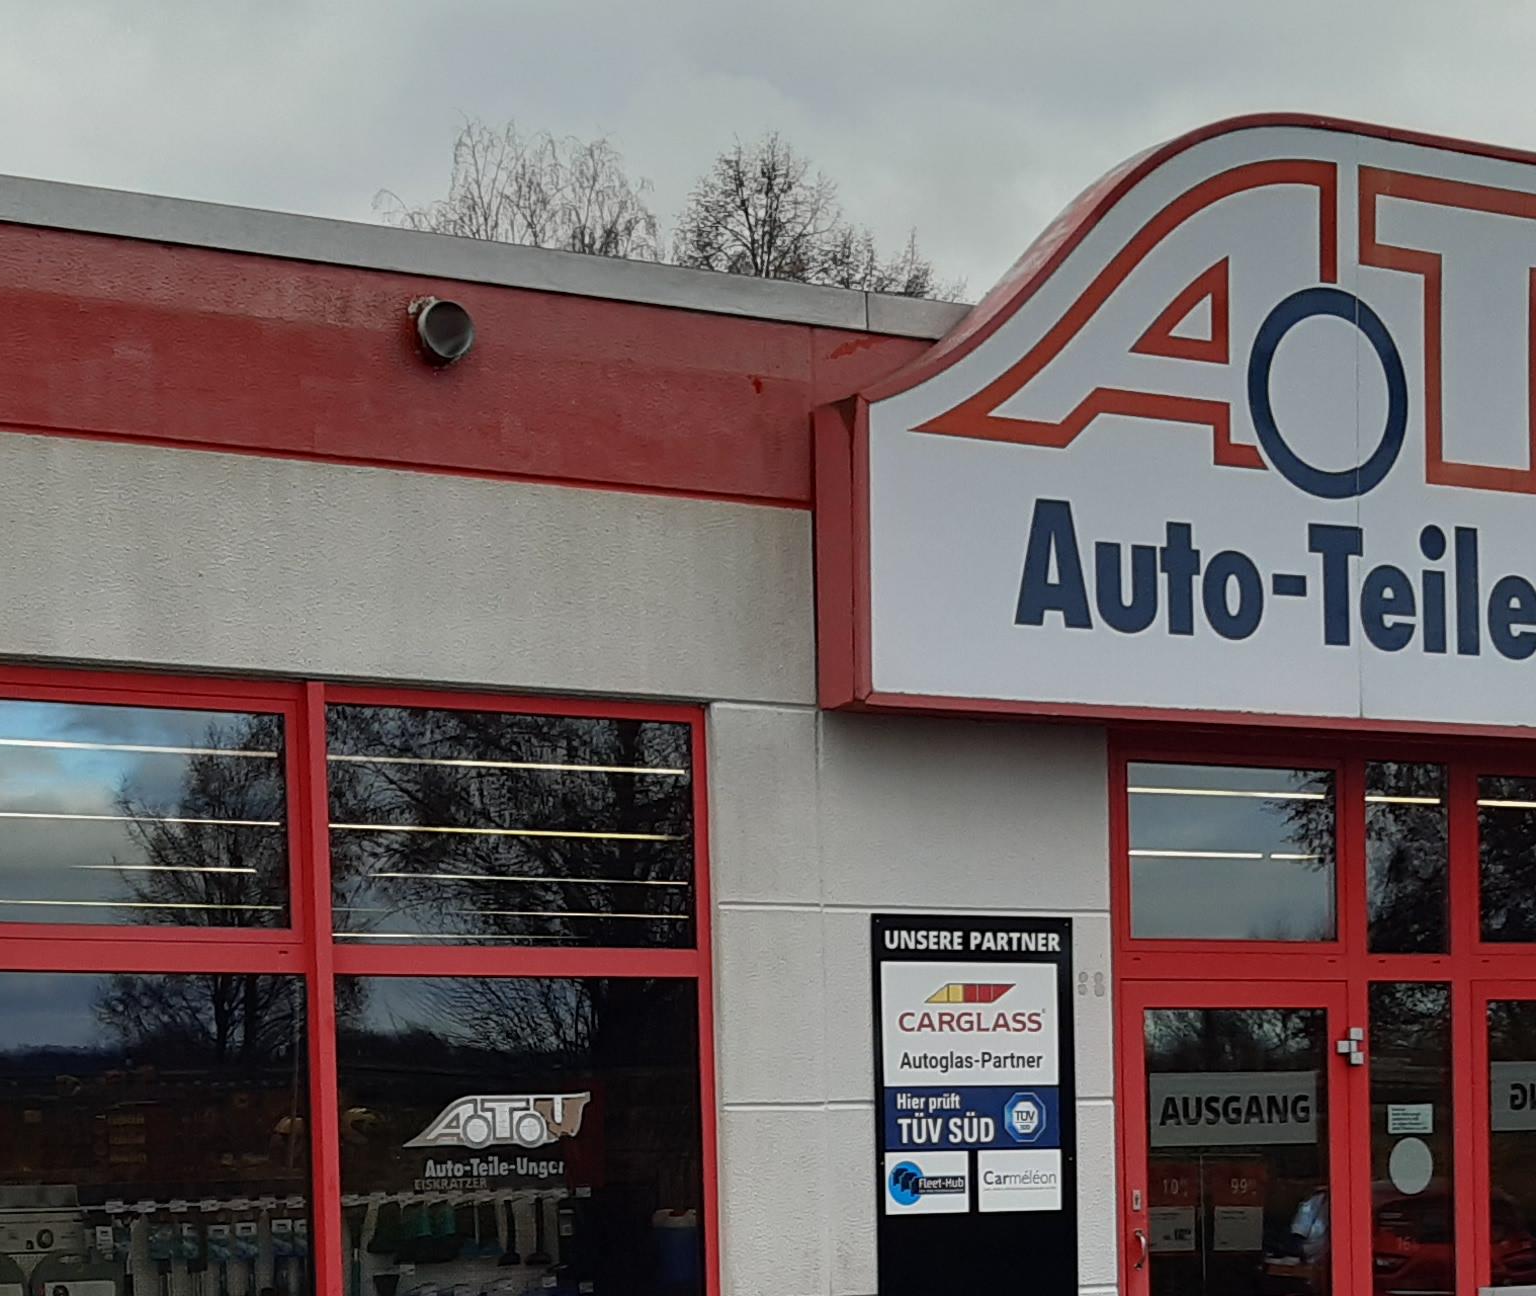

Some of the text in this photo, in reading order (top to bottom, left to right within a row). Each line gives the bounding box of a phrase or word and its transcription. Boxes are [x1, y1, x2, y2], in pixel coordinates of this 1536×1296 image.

[885, 930, 1061, 952] UNSERE PARTNER
[898, 1011, 1043, 1033] CARGLASS
[899, 1051, 1044, 1073] Autoglas-Partner
[896, 1093, 961, 1113] Hier prüft
[1159, 1094, 1311, 1127] AUSGANG
[897, 1111, 995, 1144] TÜV SÜD
[918, 1176, 965, 1189] Fleet-Hub
[983, 1170, 1057, 1185] Carméléon
